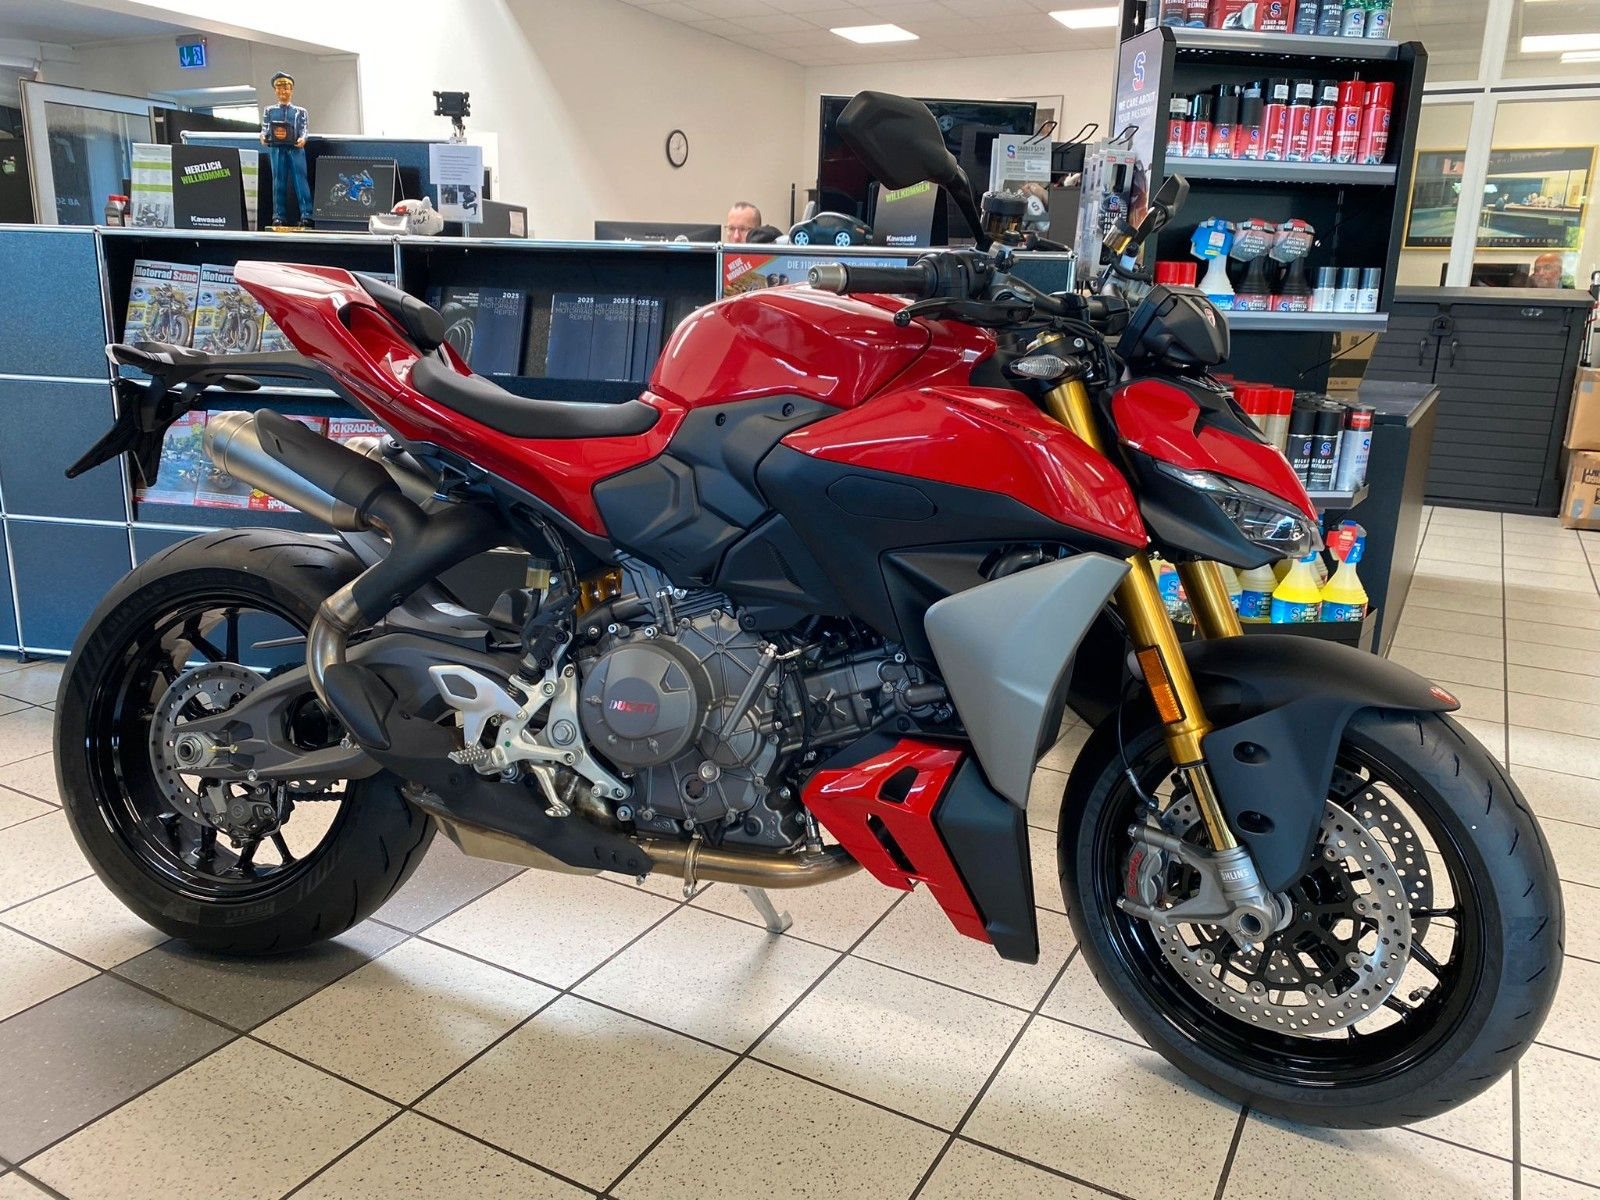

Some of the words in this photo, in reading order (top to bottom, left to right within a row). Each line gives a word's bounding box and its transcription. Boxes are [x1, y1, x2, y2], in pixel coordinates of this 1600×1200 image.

[184, 161, 222, 175] HERZLICH
[180, 168, 231, 185] WILLKOMMEN
[190, 215, 226, 224] Kawasaki
[886, 234, 917, 243] Kawasaki
[135, 265, 172, 280] Motorrad
[172, 270, 197, 283] Szene
[202, 271, 236, 284] Motorra
